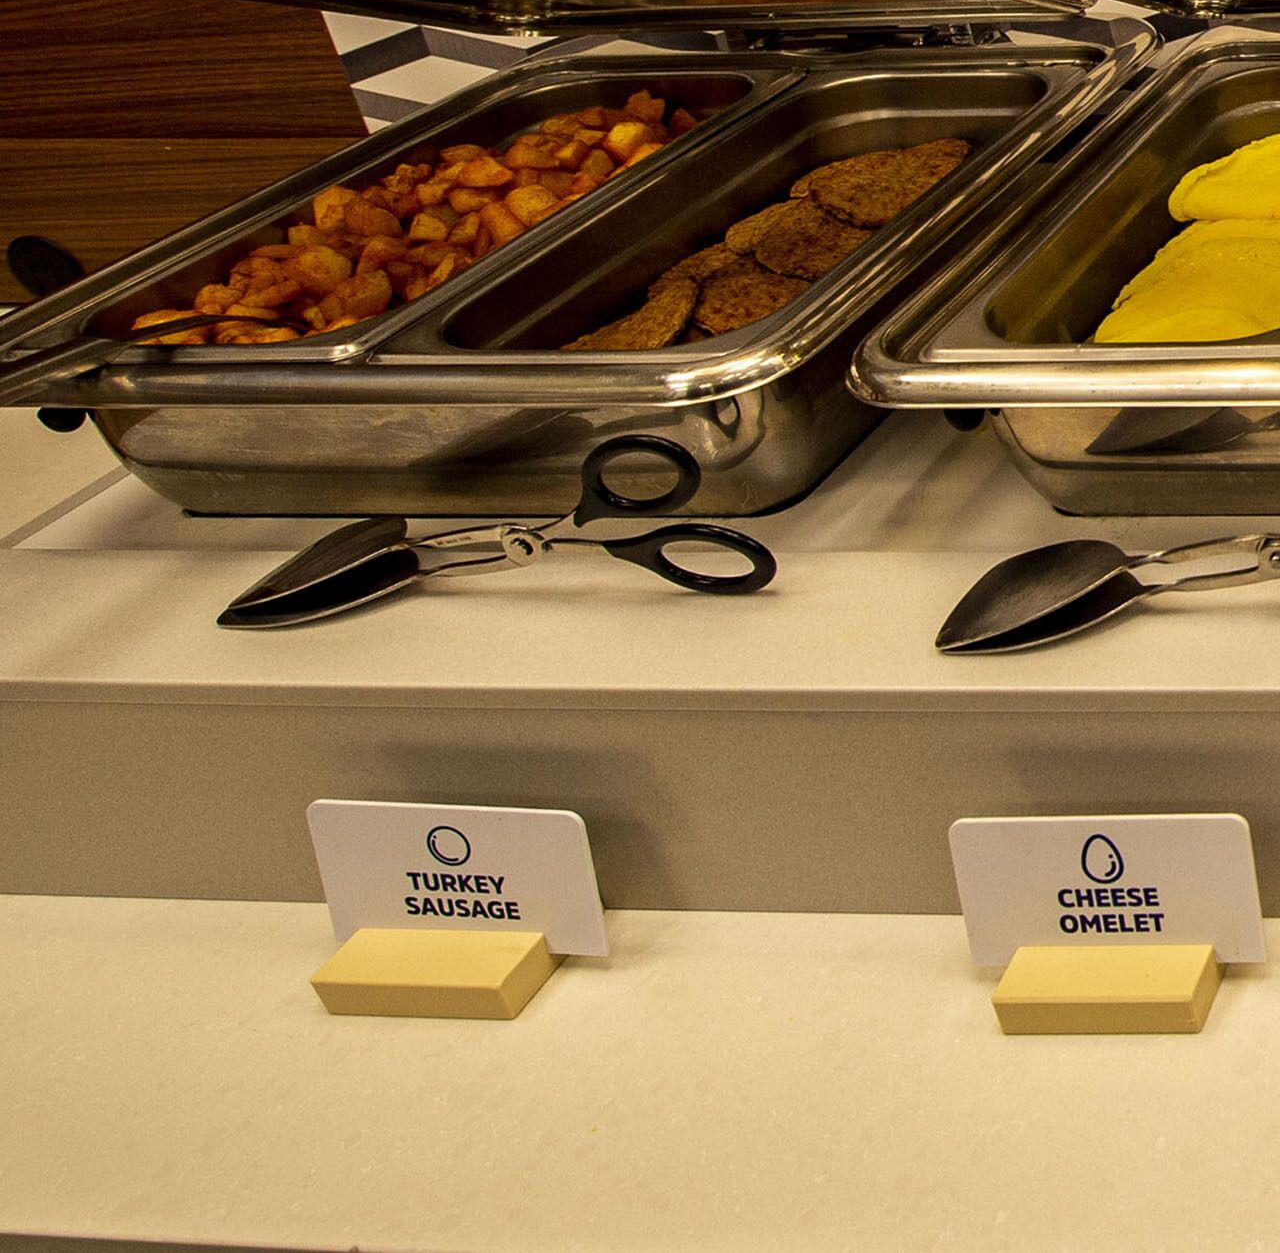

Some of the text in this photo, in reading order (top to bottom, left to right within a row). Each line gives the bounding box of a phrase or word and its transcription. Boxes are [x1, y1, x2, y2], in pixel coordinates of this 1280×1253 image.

[406, 871, 505, 895] TURKEY
[404, 896, 521, 920] SAUSAGE
[1057, 887, 1160, 909] CHEESE
[1058, 912, 1165, 935] OMELET
